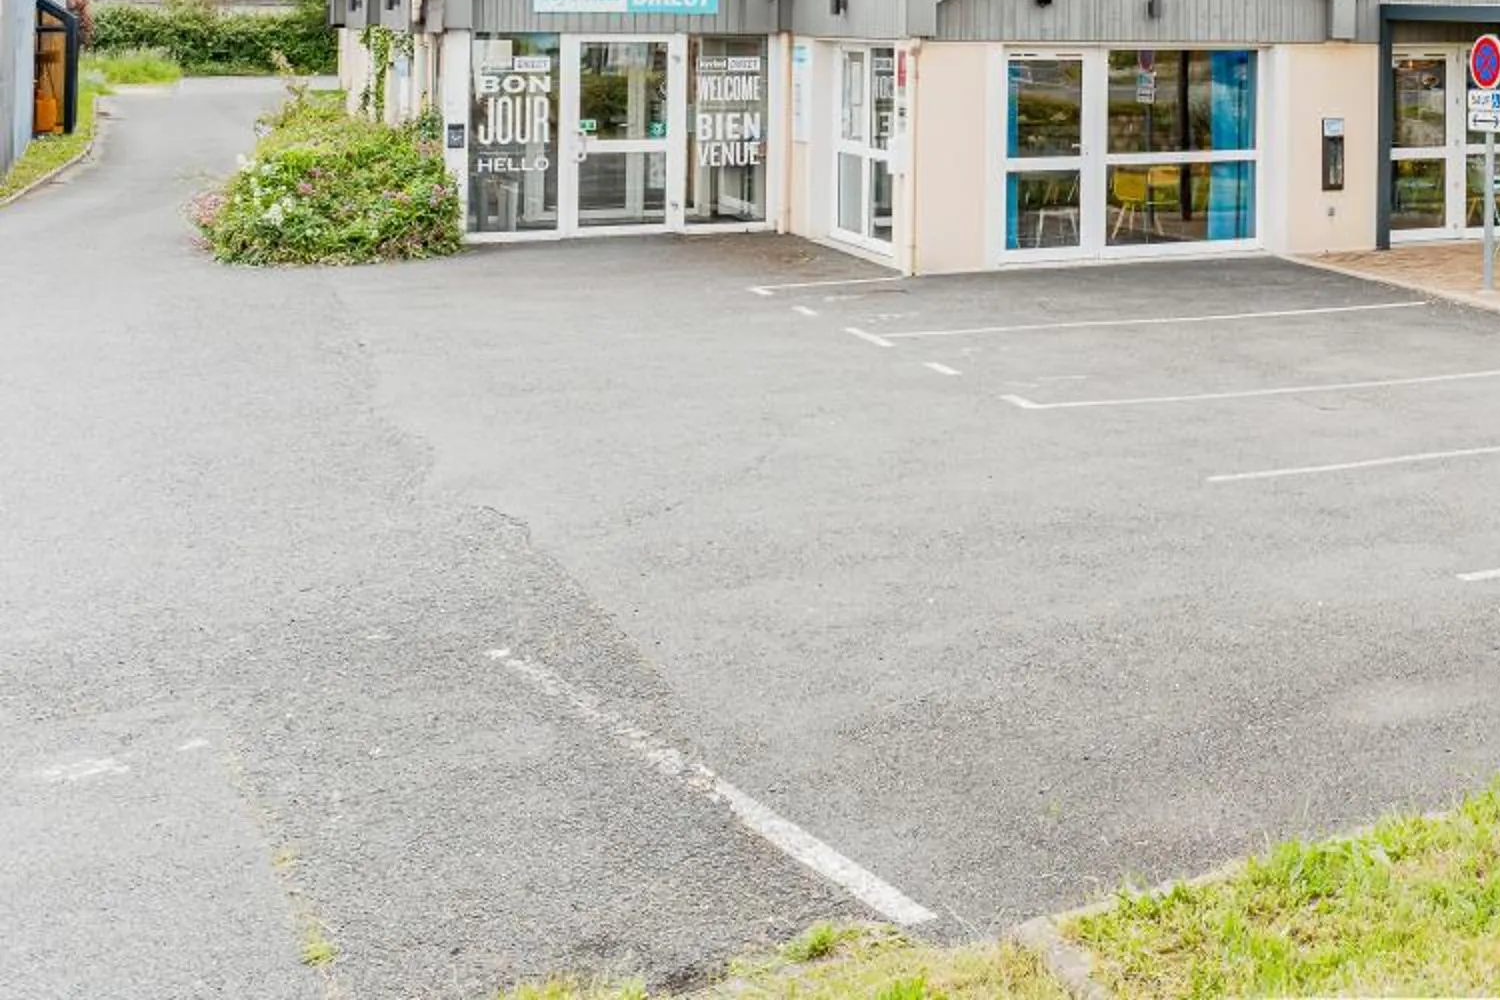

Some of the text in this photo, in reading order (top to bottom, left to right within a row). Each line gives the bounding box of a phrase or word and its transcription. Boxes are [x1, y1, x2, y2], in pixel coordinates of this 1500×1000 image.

[480, 75, 551, 93] BON
[697, 75, 760, 101] WELCOME
[478, 95, 550, 145] JOUR
[697, 112, 760, 140] BIEN
[477, 157, 550, 172] HELLO
[697, 141, 760, 167] VENUE
